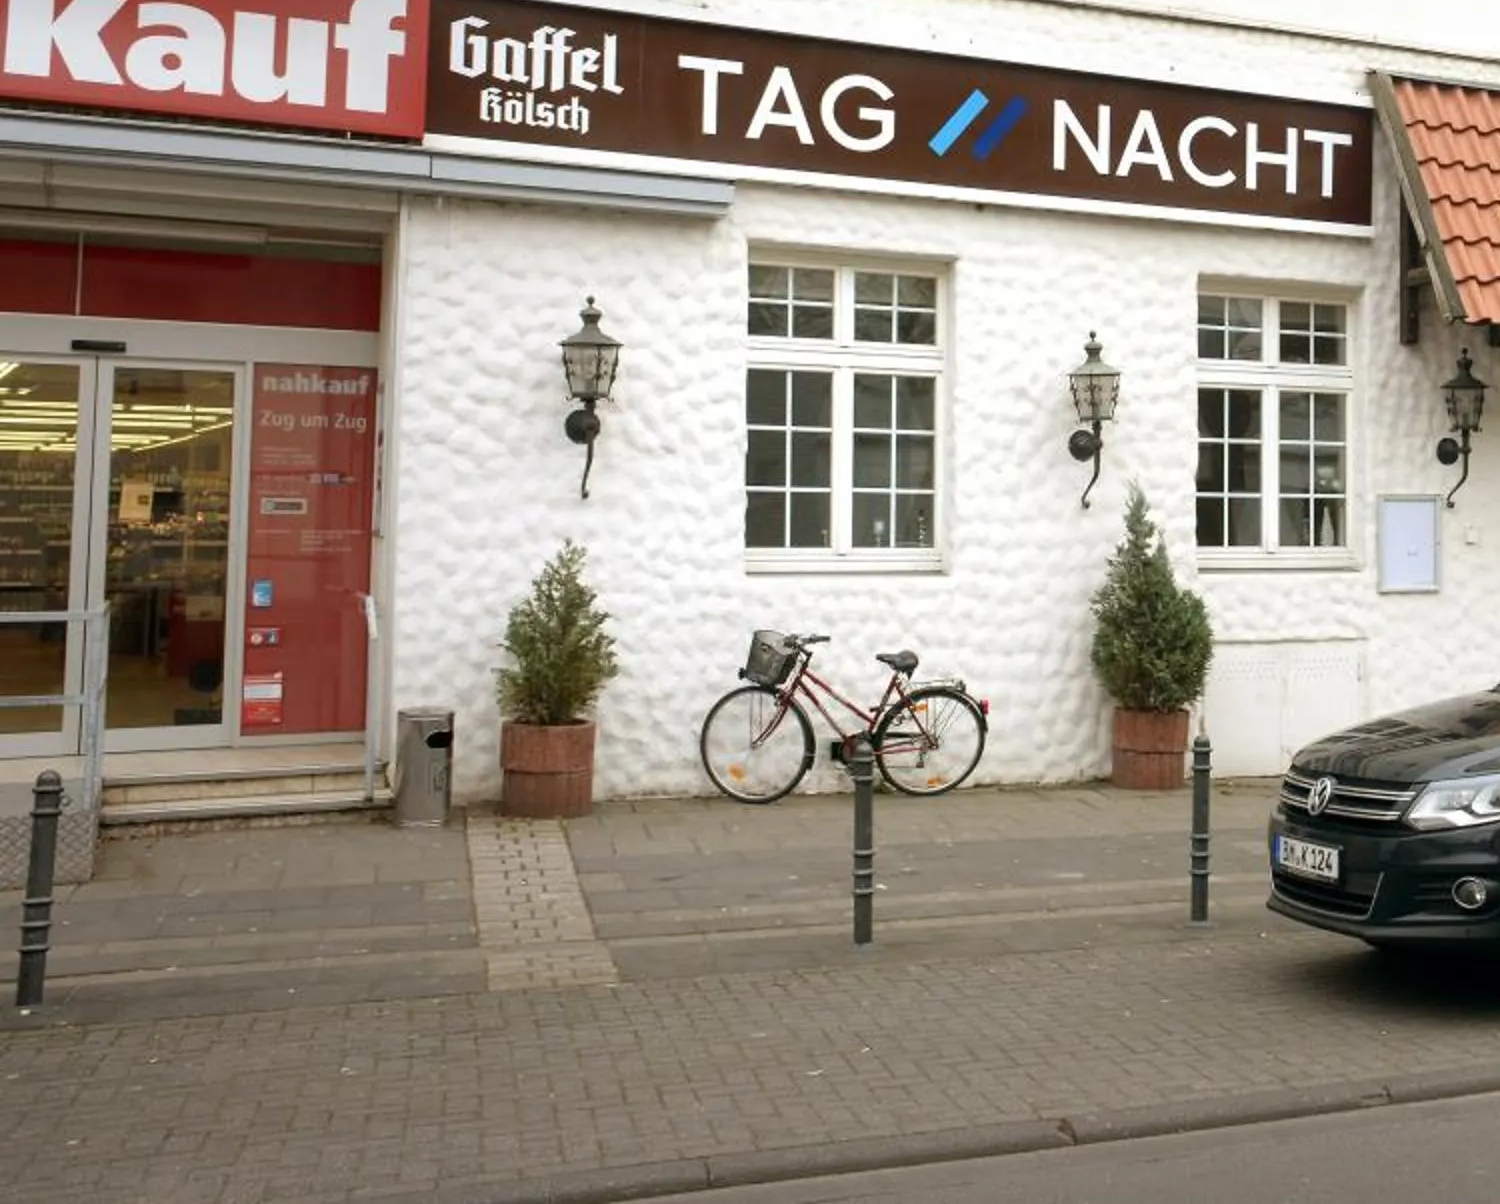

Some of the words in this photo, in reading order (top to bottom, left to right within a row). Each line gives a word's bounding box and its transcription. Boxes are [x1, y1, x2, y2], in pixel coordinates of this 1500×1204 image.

[449, 15, 625, 95] Gaffel
[479, 87, 590, 135] Kölsch
[678, 54, 896, 152] TAG
[1052, 99, 1353, 197] NACHT
[262, 372, 370, 395] nahkauf
[260, 409, 296, 432] Zug
[301, 413, 330, 429] um
[334, 412, 368, 434] Zug
